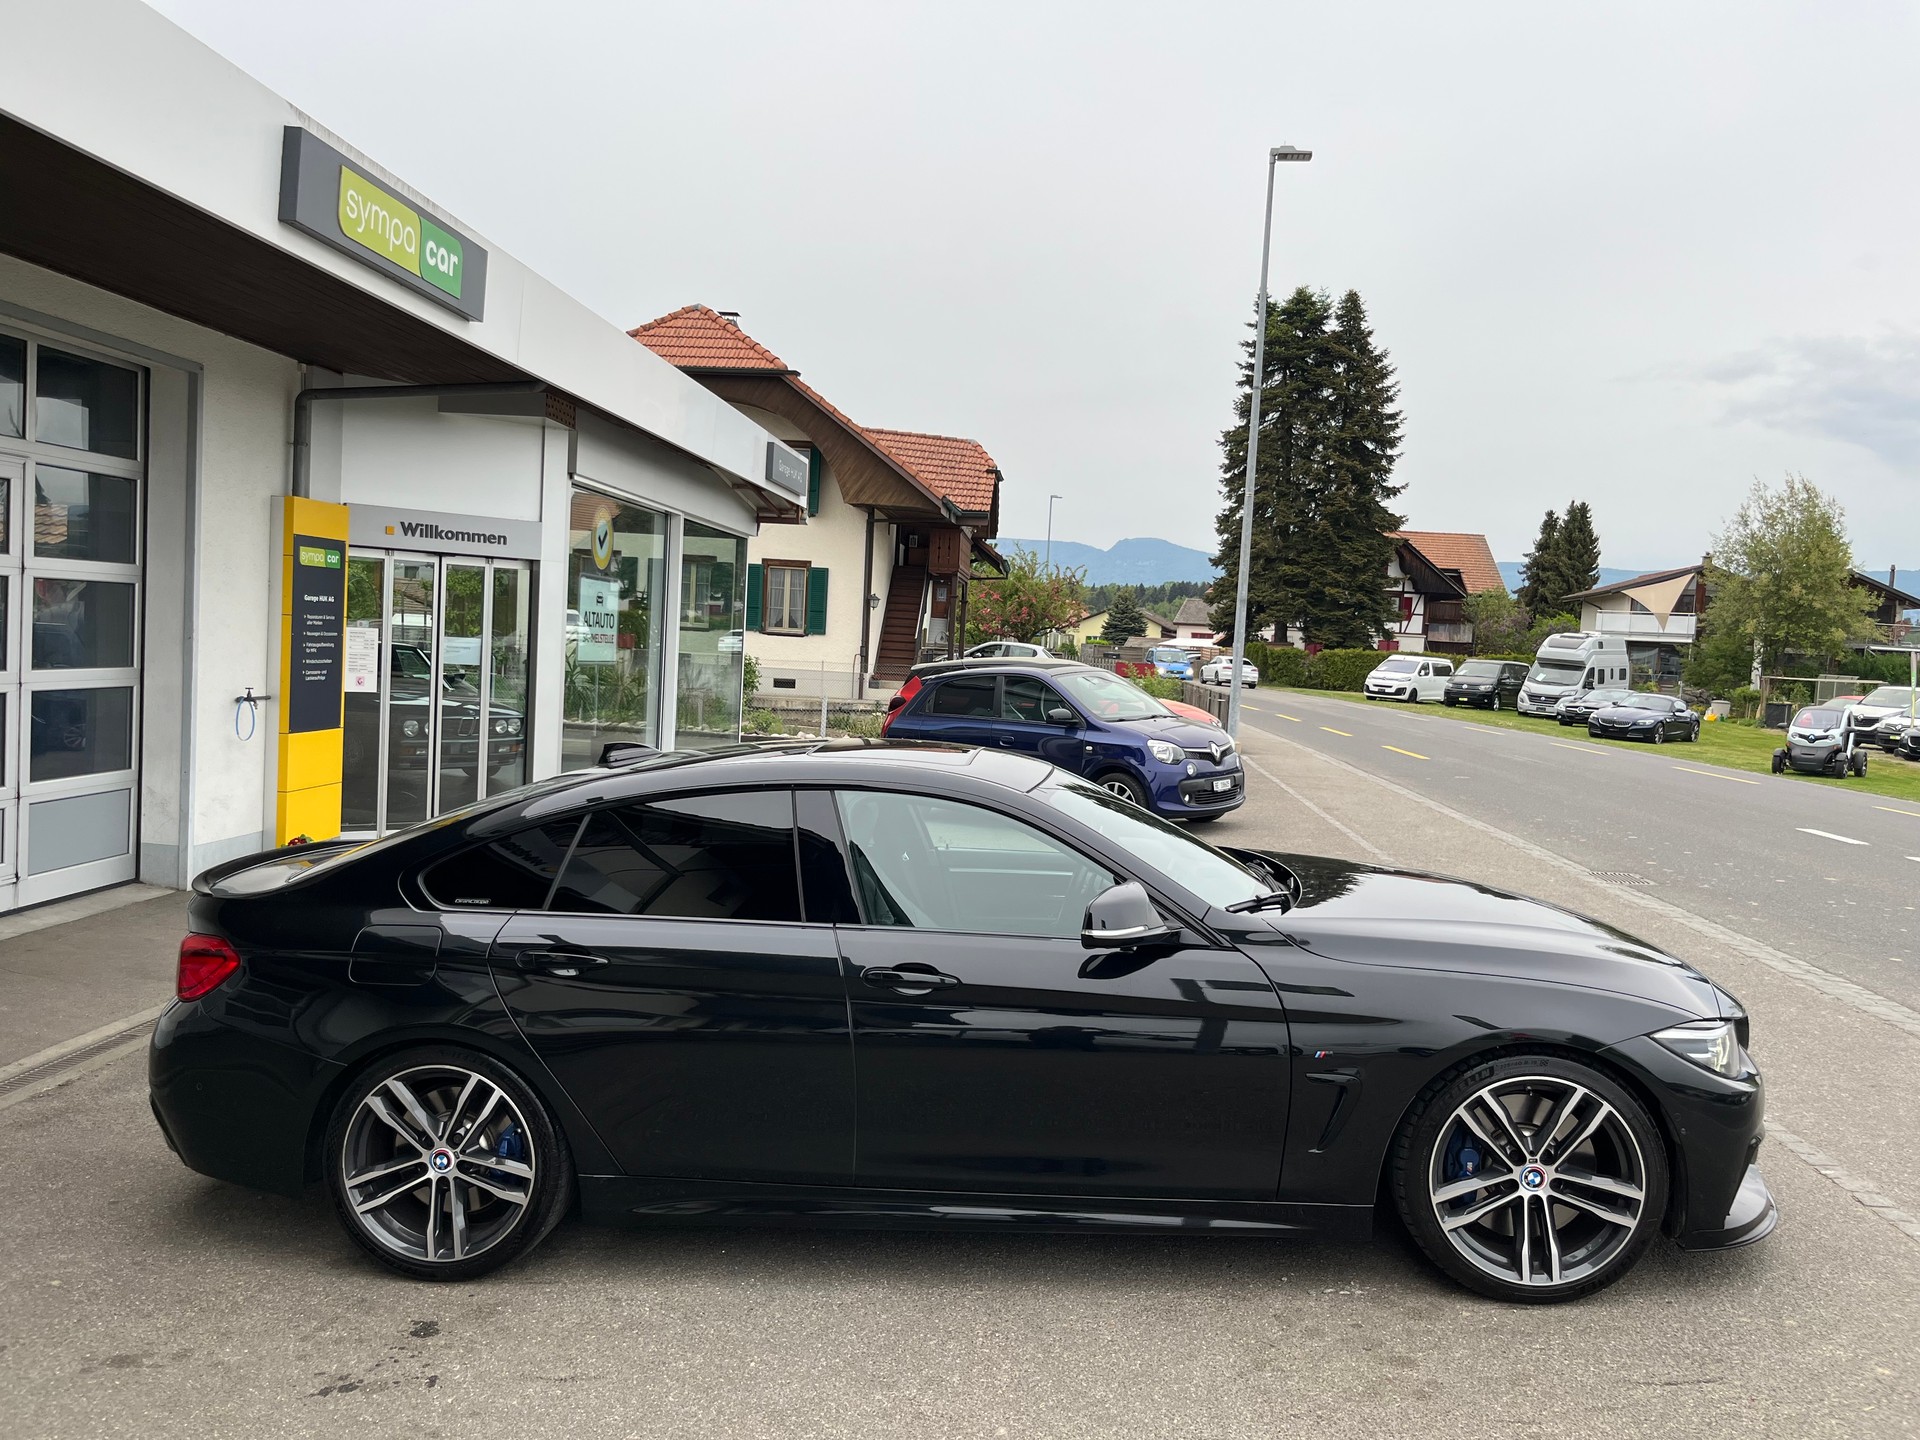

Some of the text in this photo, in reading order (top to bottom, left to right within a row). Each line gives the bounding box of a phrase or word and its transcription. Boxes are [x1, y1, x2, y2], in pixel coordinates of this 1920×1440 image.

[346, 189, 459, 277] sympa car
[400, 521, 508, 546] Willkommen
[301, 551, 340, 564] sympa car
[304, 594, 319, 603] Garage
[583, 611, 615, 629] ALTAUTO
[582, 633, 615, 644] SAMELSTELLE
